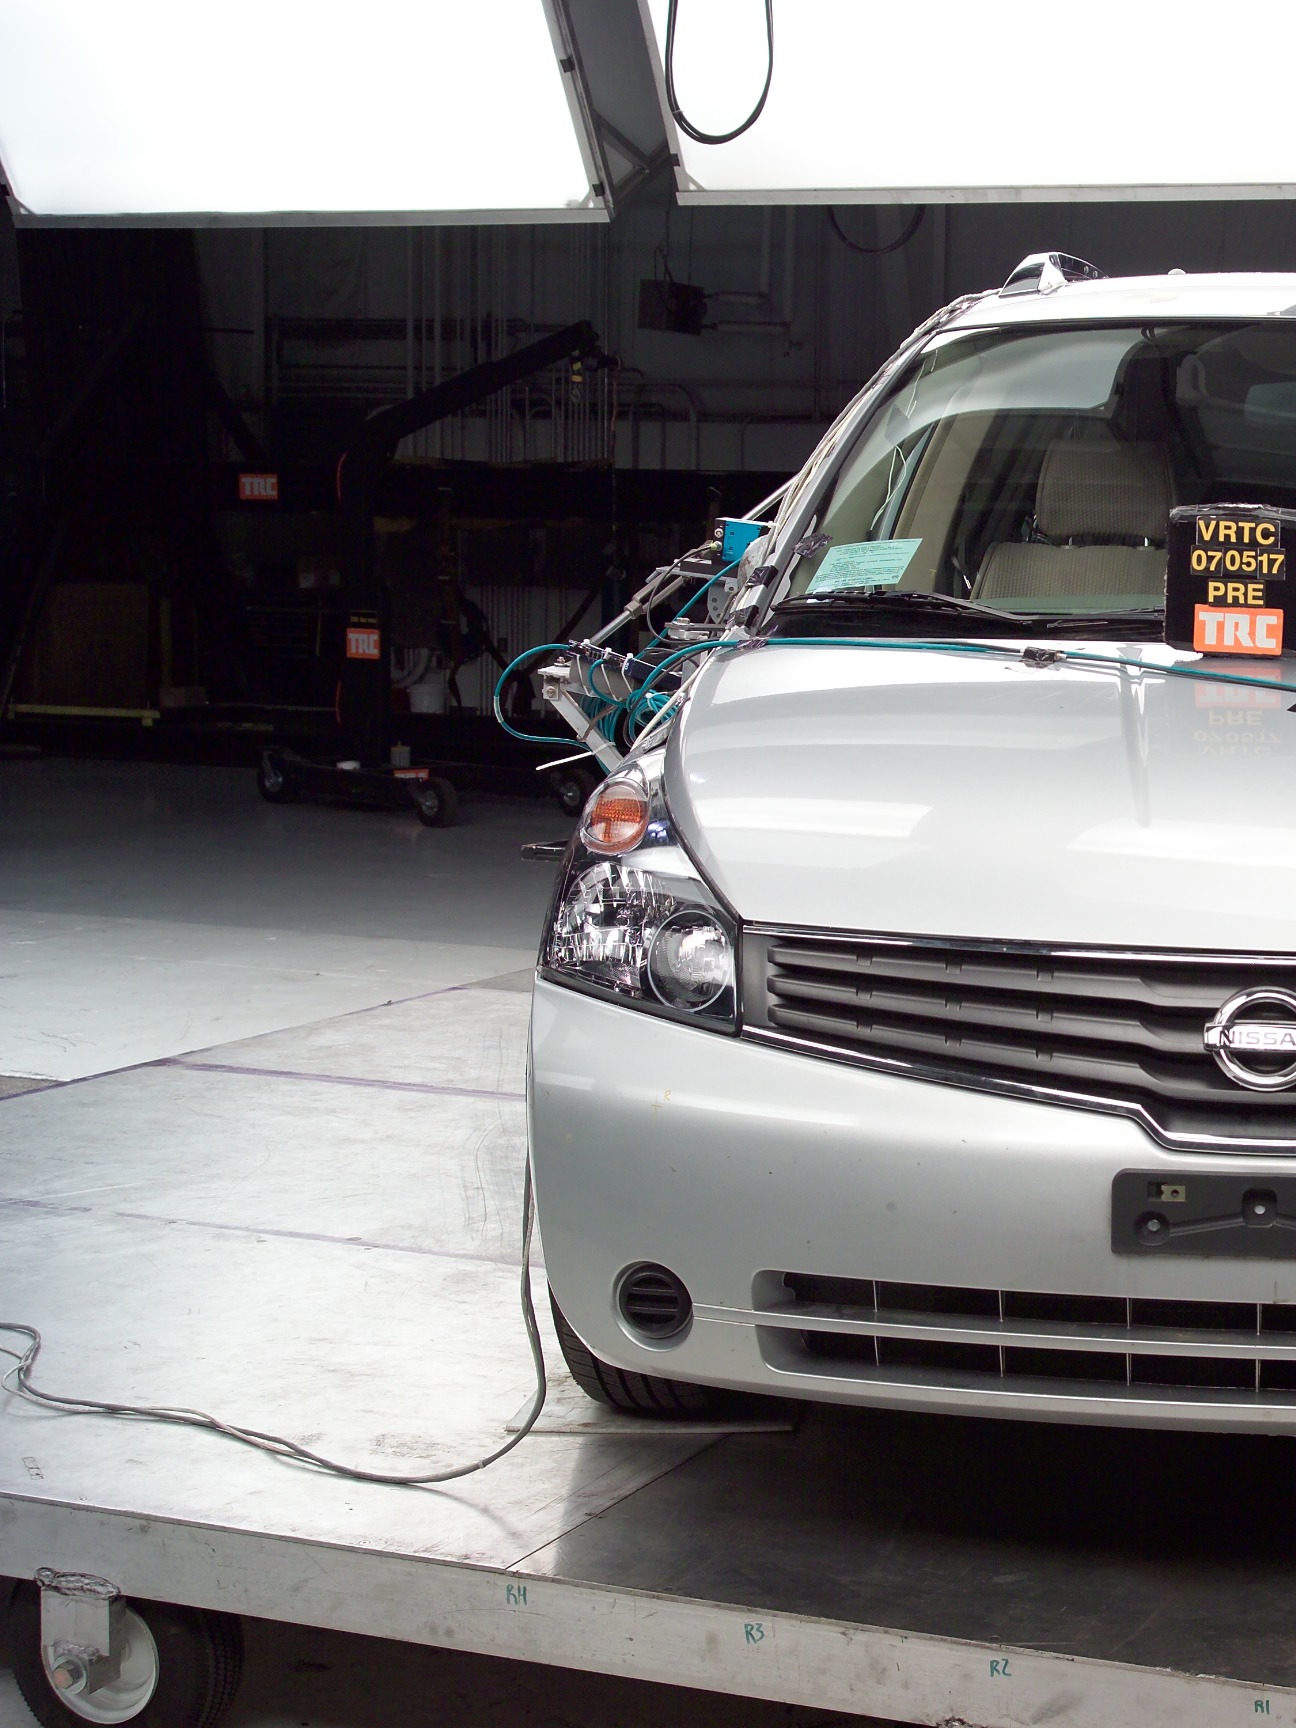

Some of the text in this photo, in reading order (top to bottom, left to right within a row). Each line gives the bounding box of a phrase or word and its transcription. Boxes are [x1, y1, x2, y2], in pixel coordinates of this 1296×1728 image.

[242, 477, 276, 496] TRC
[1198, 520, 1276, 545] VRTC
[1191, 550, 1285, 574] 070517
[1208, 581, 1264, 605] PRE
[1198, 611, 1277, 648] TRC
[348, 632, 379, 655] TRC
[744, 1623, 765, 1644] R3
[989, 1659, 1012, 1677] R2
[1254, 1700, 1270, 1715] R1
